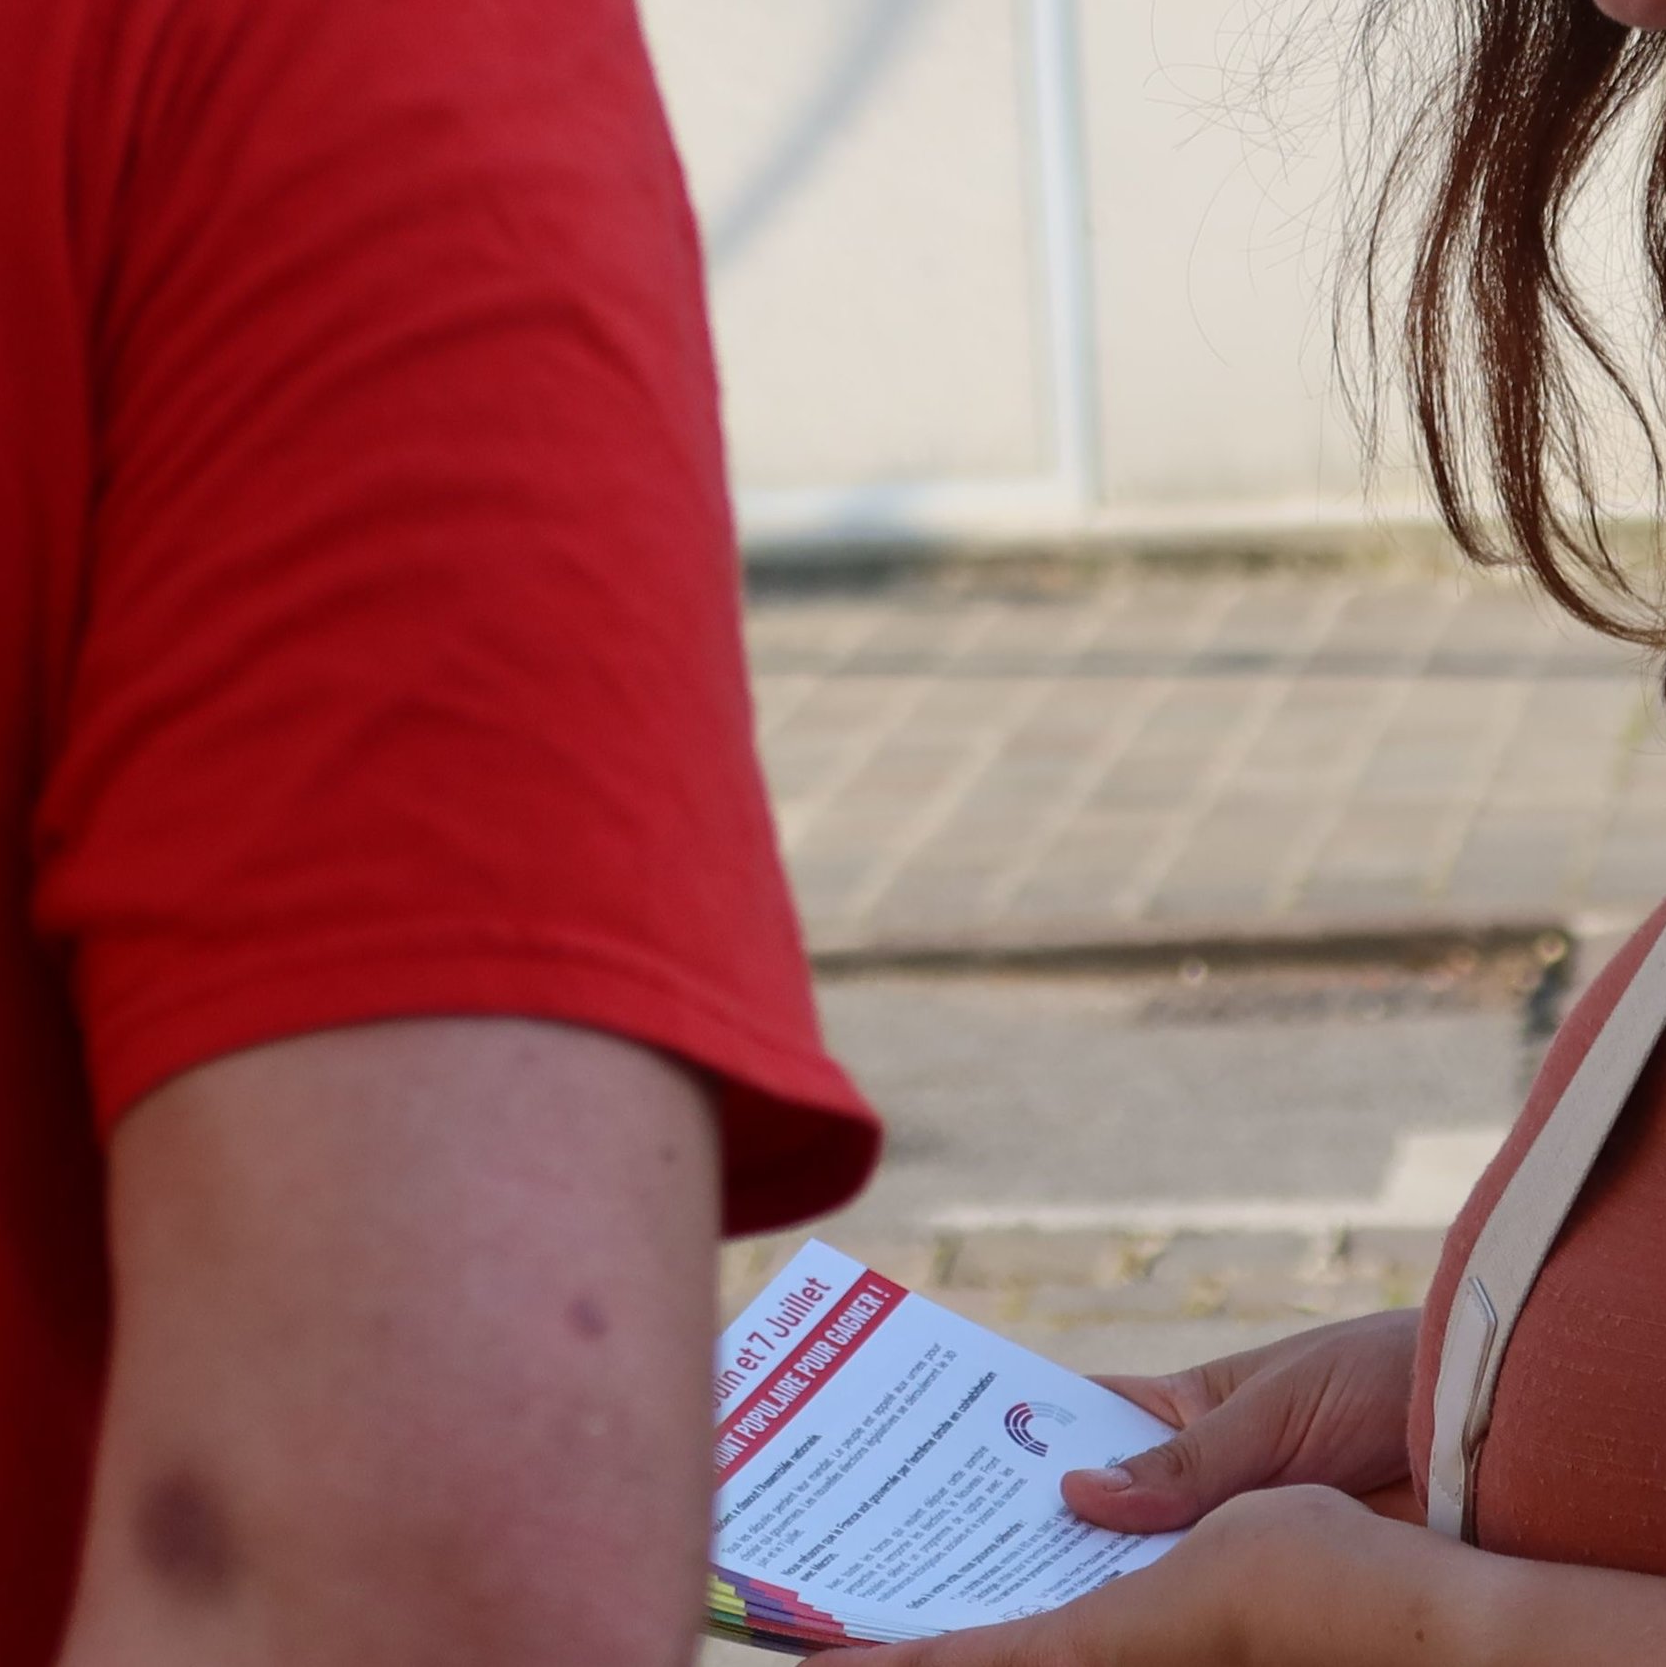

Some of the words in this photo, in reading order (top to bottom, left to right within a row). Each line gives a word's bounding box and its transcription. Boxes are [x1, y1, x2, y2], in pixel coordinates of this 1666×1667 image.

[766, 1277, 831, 1337] Juillet
[735, 1347, 766, 1370] et
[747, 1331, 776, 1350] 7
[733, 1372, 810, 1439] POPULAIRE
[793, 1338, 840, 1378] POUR
[830, 1291, 885, 1345] GAGNER
[867, 1284, 891, 1298] !
